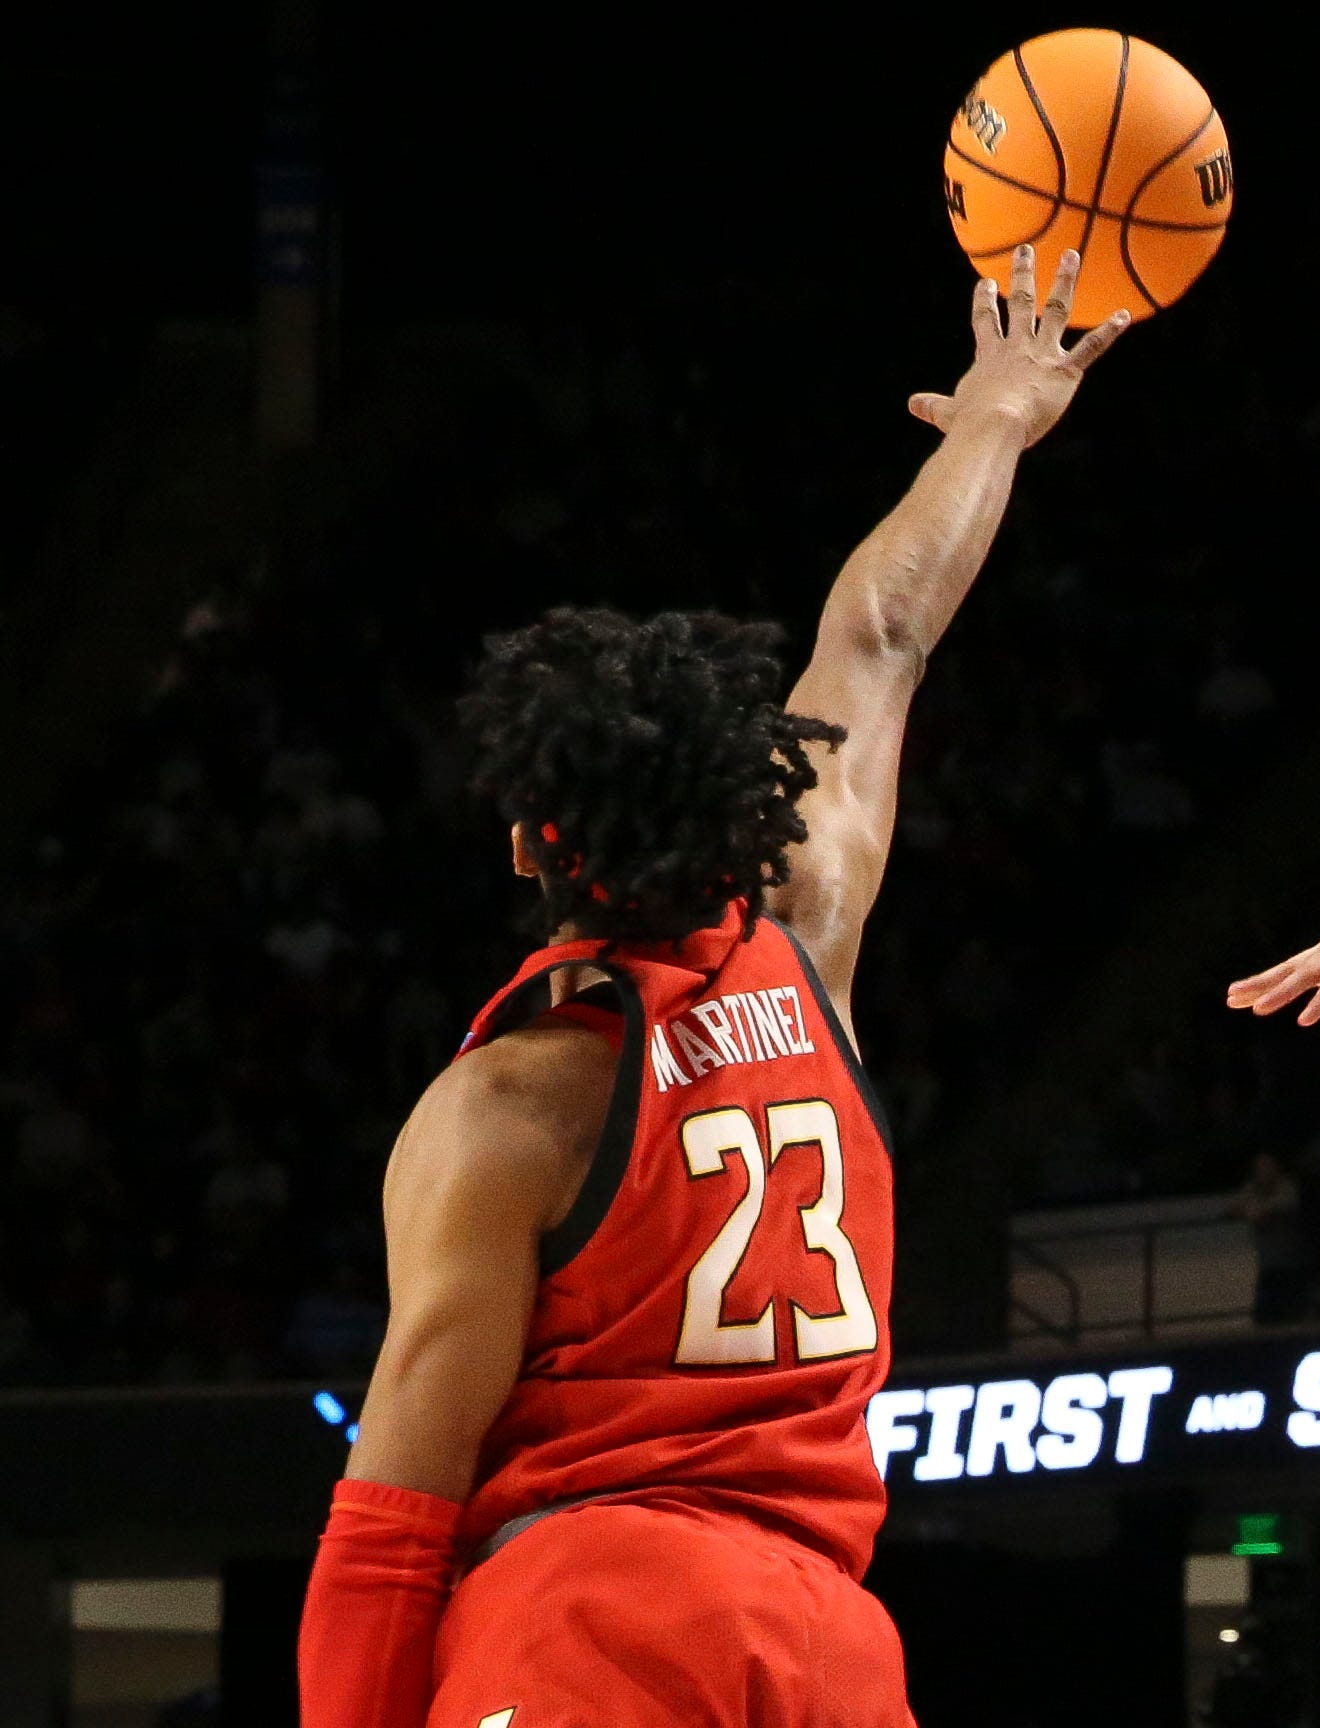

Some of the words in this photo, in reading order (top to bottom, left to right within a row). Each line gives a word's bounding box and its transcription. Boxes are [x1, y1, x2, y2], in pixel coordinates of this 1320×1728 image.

[650, 985, 815, 1093] MARTINEZ
[672, 1097, 878, 1370] 23
[866, 1366, 1175, 1482] FIRST
